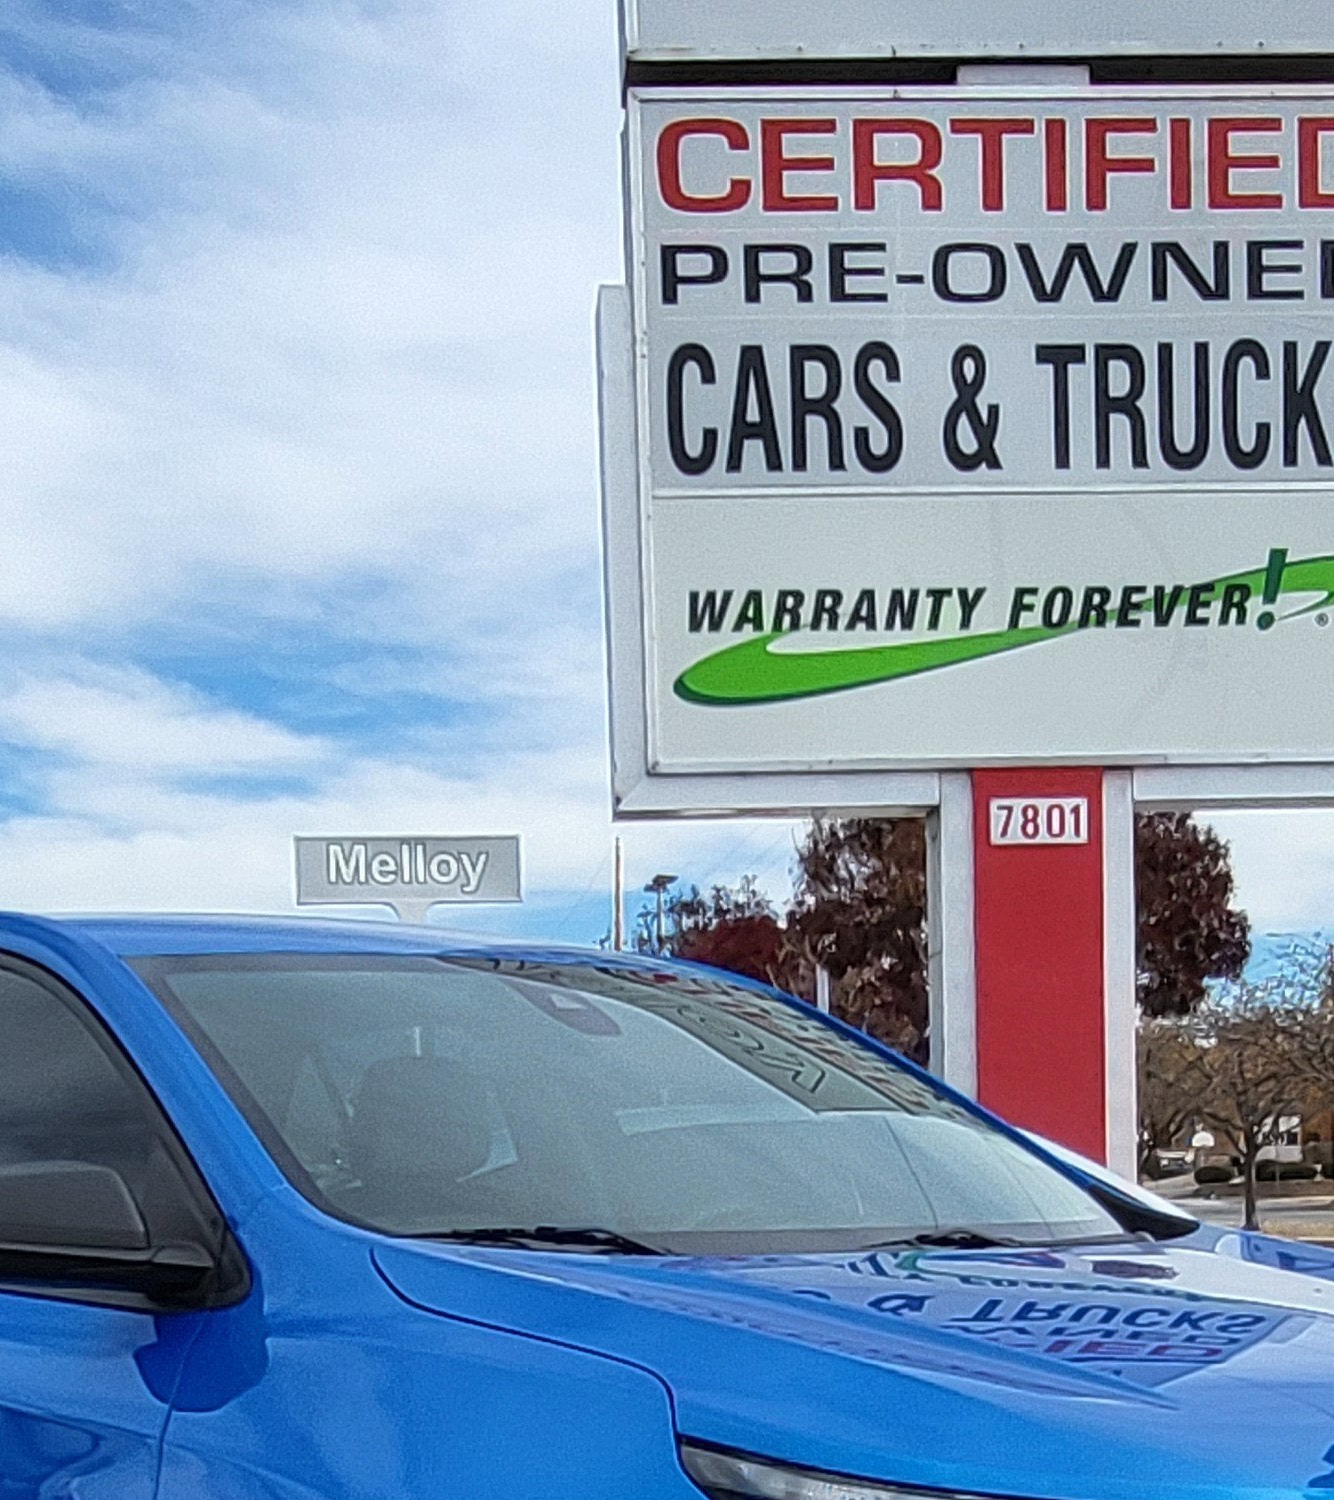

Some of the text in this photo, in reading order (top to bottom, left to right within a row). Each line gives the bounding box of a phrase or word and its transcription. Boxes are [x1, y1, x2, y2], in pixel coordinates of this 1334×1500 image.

[667, 340, 904, 475] CARS
[942, 343, 1003, 472] &
[687, 547, 1289, 633] WARRANTY FOREVER!
[996, 803, 1082, 839] 7801
[326, 843, 490, 893] Melloy
